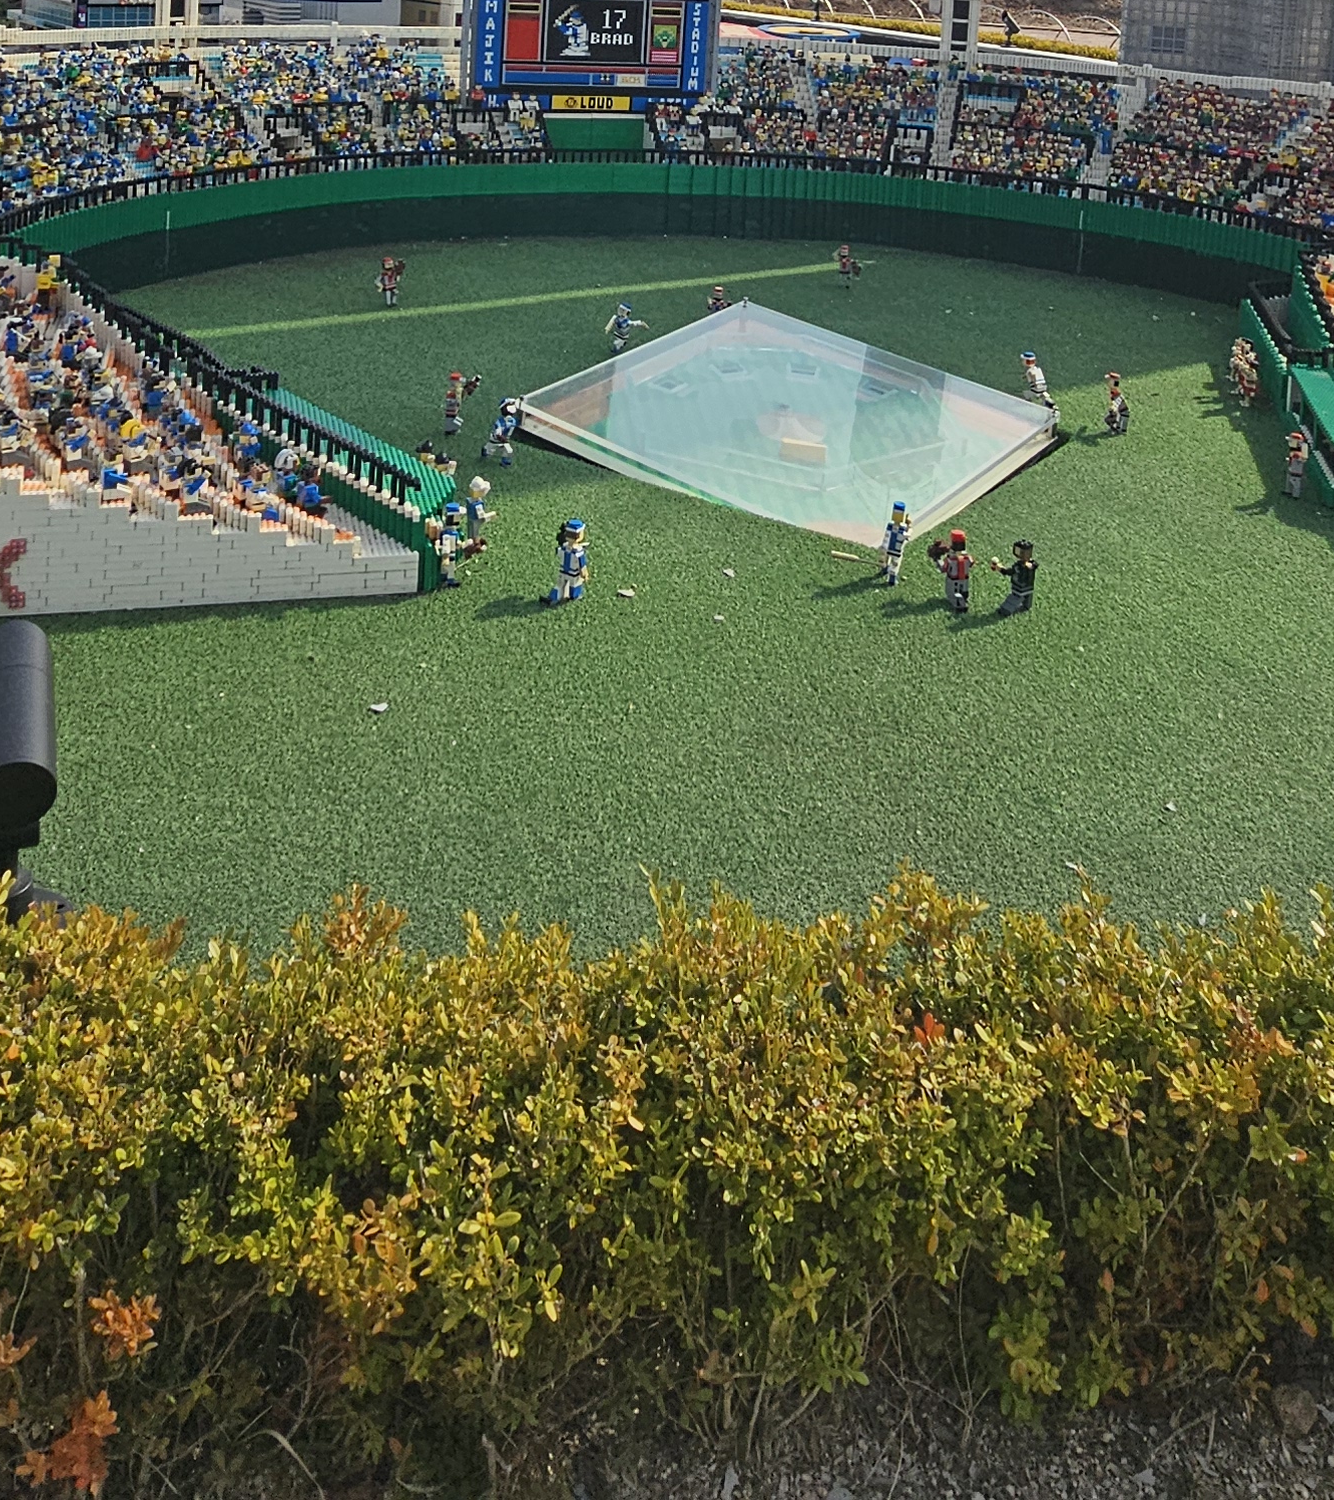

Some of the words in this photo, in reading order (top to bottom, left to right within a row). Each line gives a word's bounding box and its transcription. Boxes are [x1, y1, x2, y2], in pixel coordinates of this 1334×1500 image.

[601, 8, 627, 30] 17
[484, 0, 498, 82] MAJIK
[589, 32, 634, 46] BRAD
[687, 2, 702, 91] STADIUM
[580, 96, 614, 109] LOUD
